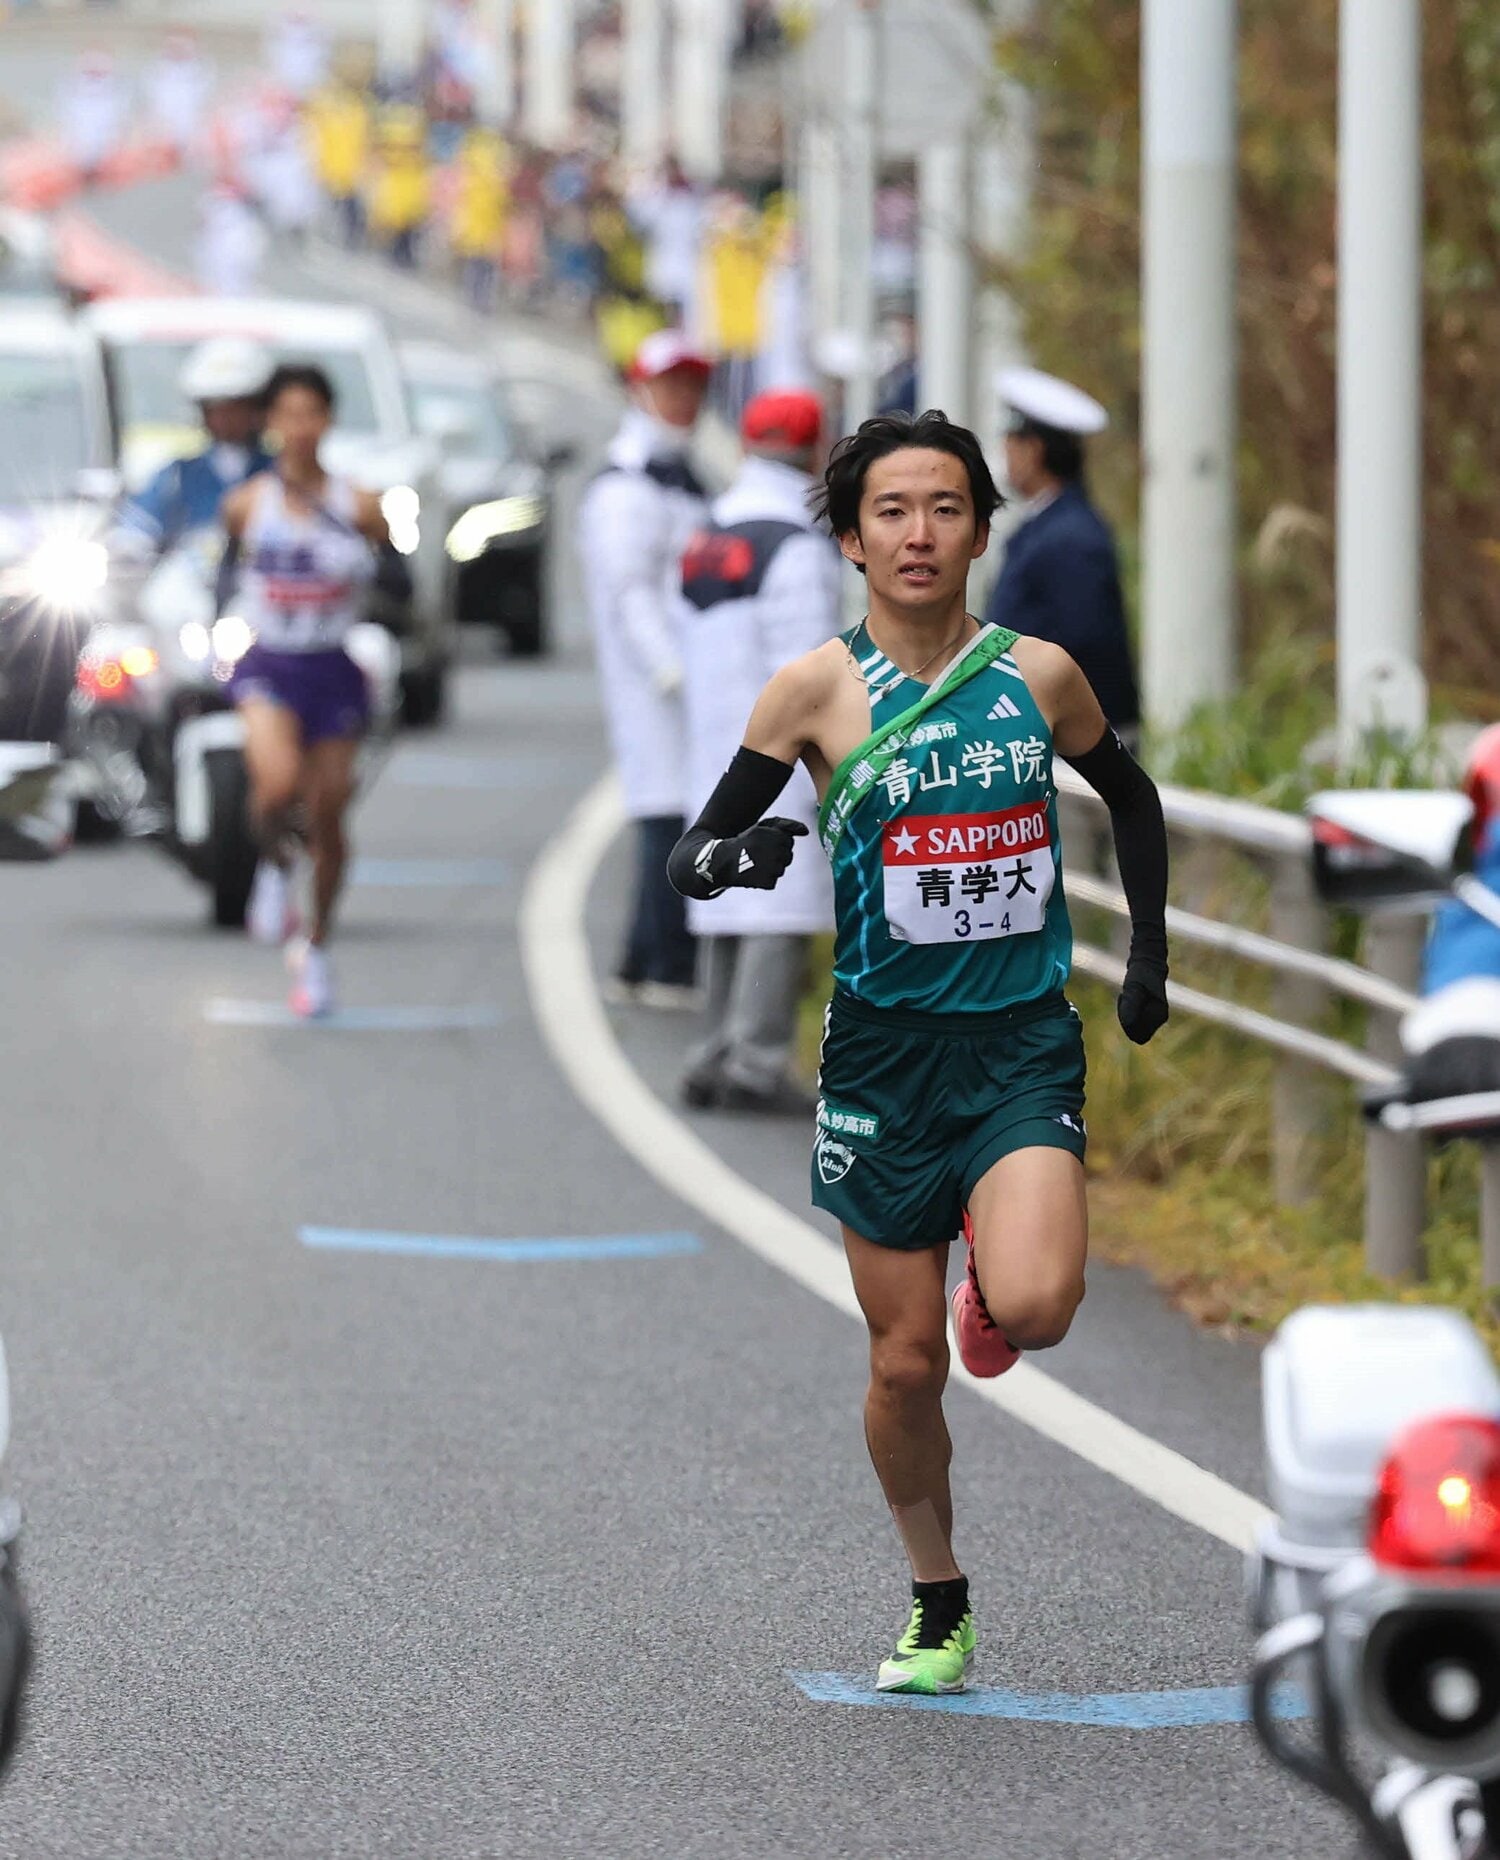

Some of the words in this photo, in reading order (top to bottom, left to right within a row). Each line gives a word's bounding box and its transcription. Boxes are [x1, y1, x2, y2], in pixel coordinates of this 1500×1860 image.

[876, 736, 1047, 806] 青山学院
[927, 812, 1044, 855] SAPPORO
[916, 858, 1037, 908] 青学大
[831, 1111, 877, 1136] 妙高市
